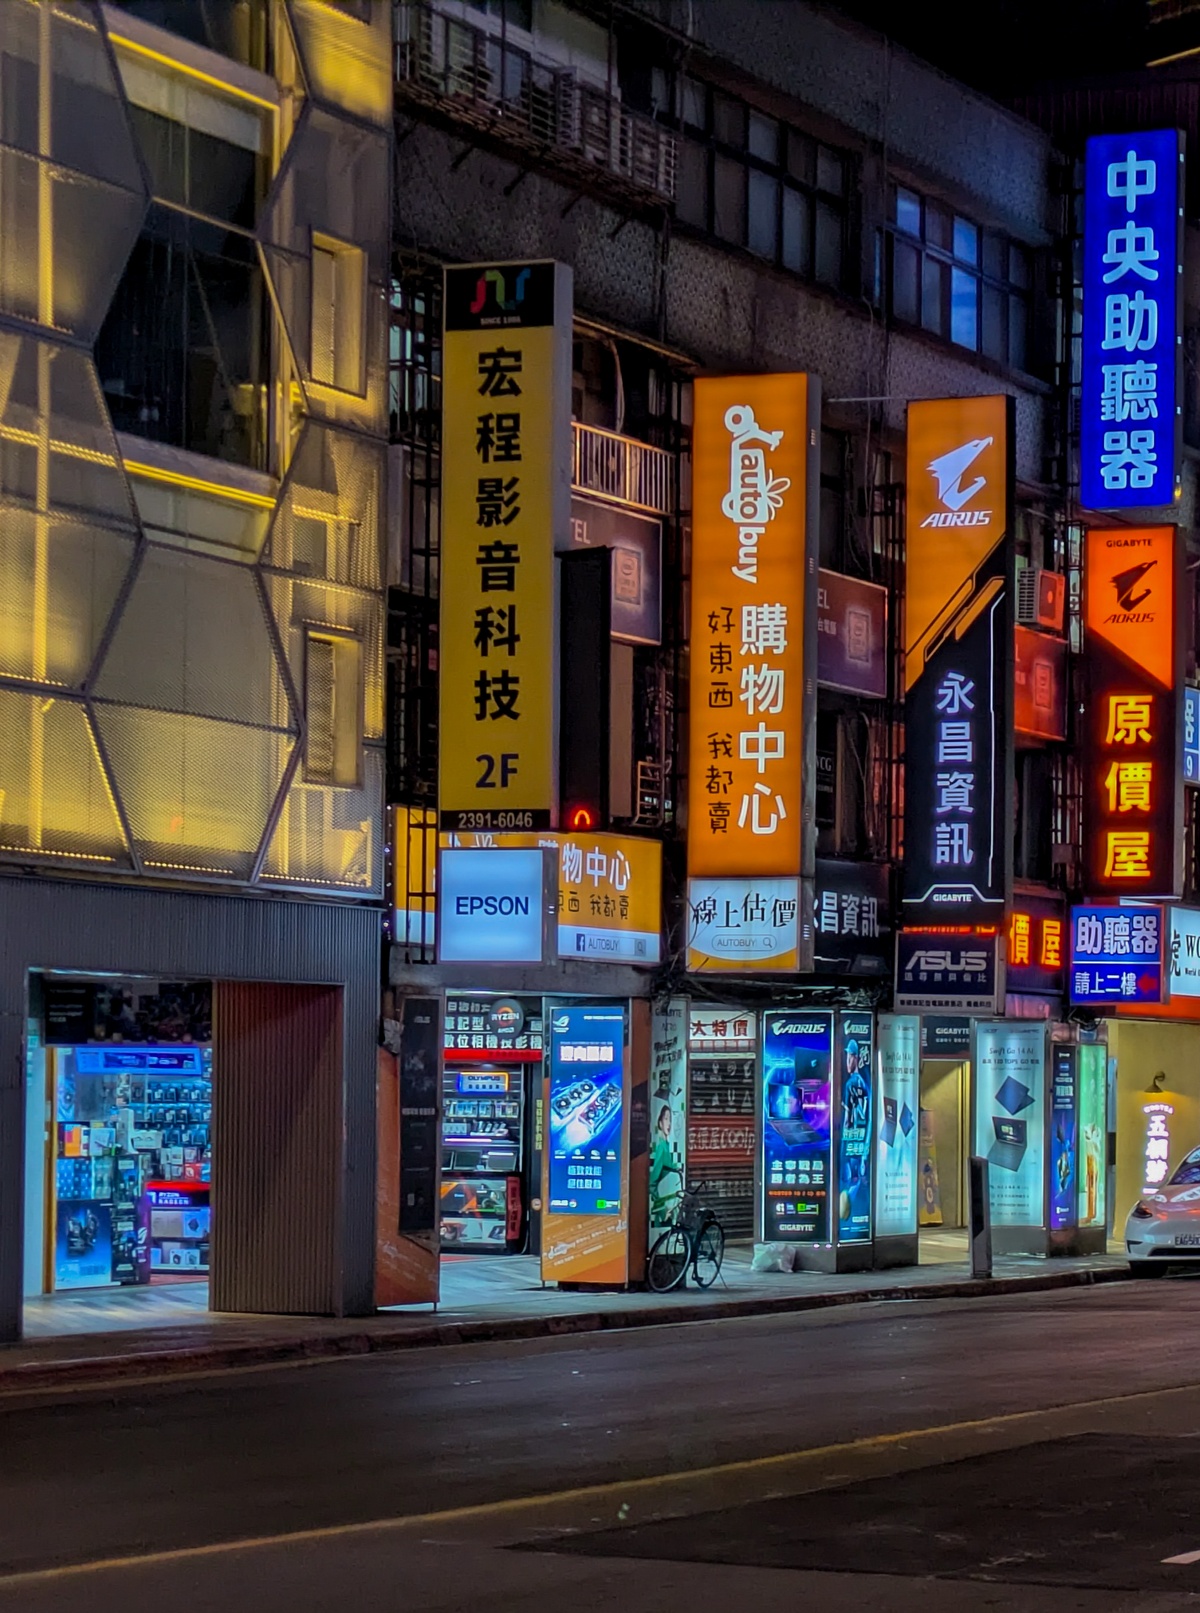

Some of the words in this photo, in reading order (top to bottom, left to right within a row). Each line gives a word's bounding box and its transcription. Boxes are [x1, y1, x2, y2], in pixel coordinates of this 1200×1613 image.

[1101, 150, 1159, 489] 中央助聽器
[569, 518, 591, 544] EL
[731, 452, 765, 584] autobuy
[920, 511, 992, 528] AORUS
[476, 347, 522, 721] 宏程影音科技
[1106, 540, 1153, 548] GIGABYTE
[1103, 613, 1155, 625] AORUS
[708, 606, 735, 709] 好東西
[738, 604, 788, 836] 購物中心
[476, 754, 519, 788] 2F
[935, 671, 975, 865] 永昌資訊
[705, 732, 734, 834] 我都賣
[1104, 695, 1152, 878] 原價屋
[458, 812, 533, 829] 2391-6046
[538, 840, 631, 891] 物中心
[456, 896, 529, 915] EPSON
[933, 893, 973, 902] GIGABYTE
[692, 893, 797, 930] 線上估價
[588, 939, 620, 950] AUTOBUY
[717, 938, 756, 948] AUTOBUY
[1076, 914, 1158, 955] 助聽器
[905, 950, 987, 972] ASUS
[1075, 971, 1137, 995] 請上二樓
[692, 1020, 748, 1037] 大特價
[783, 1023, 826, 1034] AORUS
